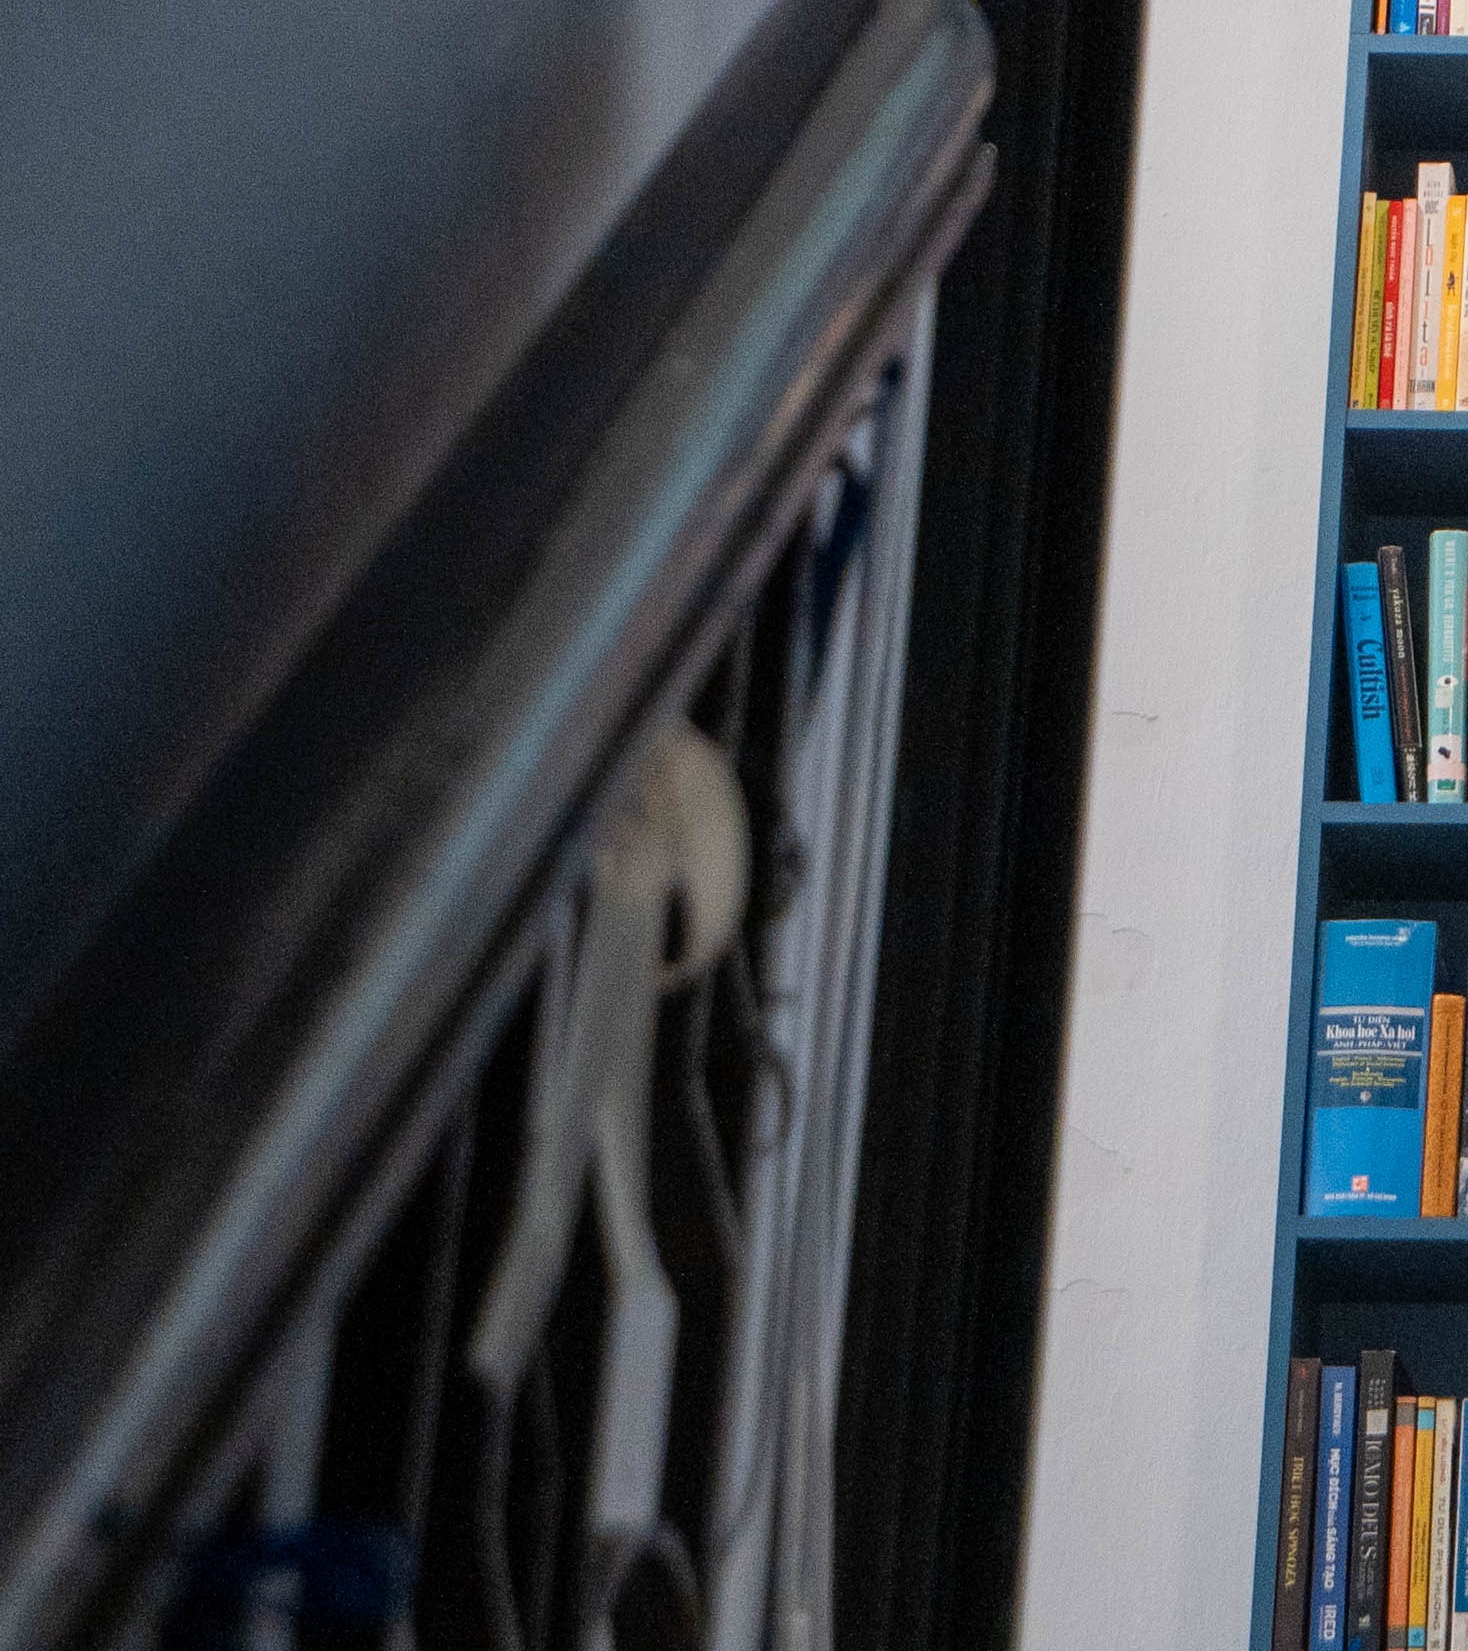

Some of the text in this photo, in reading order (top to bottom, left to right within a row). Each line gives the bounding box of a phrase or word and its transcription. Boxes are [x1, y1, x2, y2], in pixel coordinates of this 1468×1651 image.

[1391, 588, 1407, 659] yakuza moon
[1356, 638, 1385, 721] Cultish
[1323, 1604, 1337, 1641] IRED
